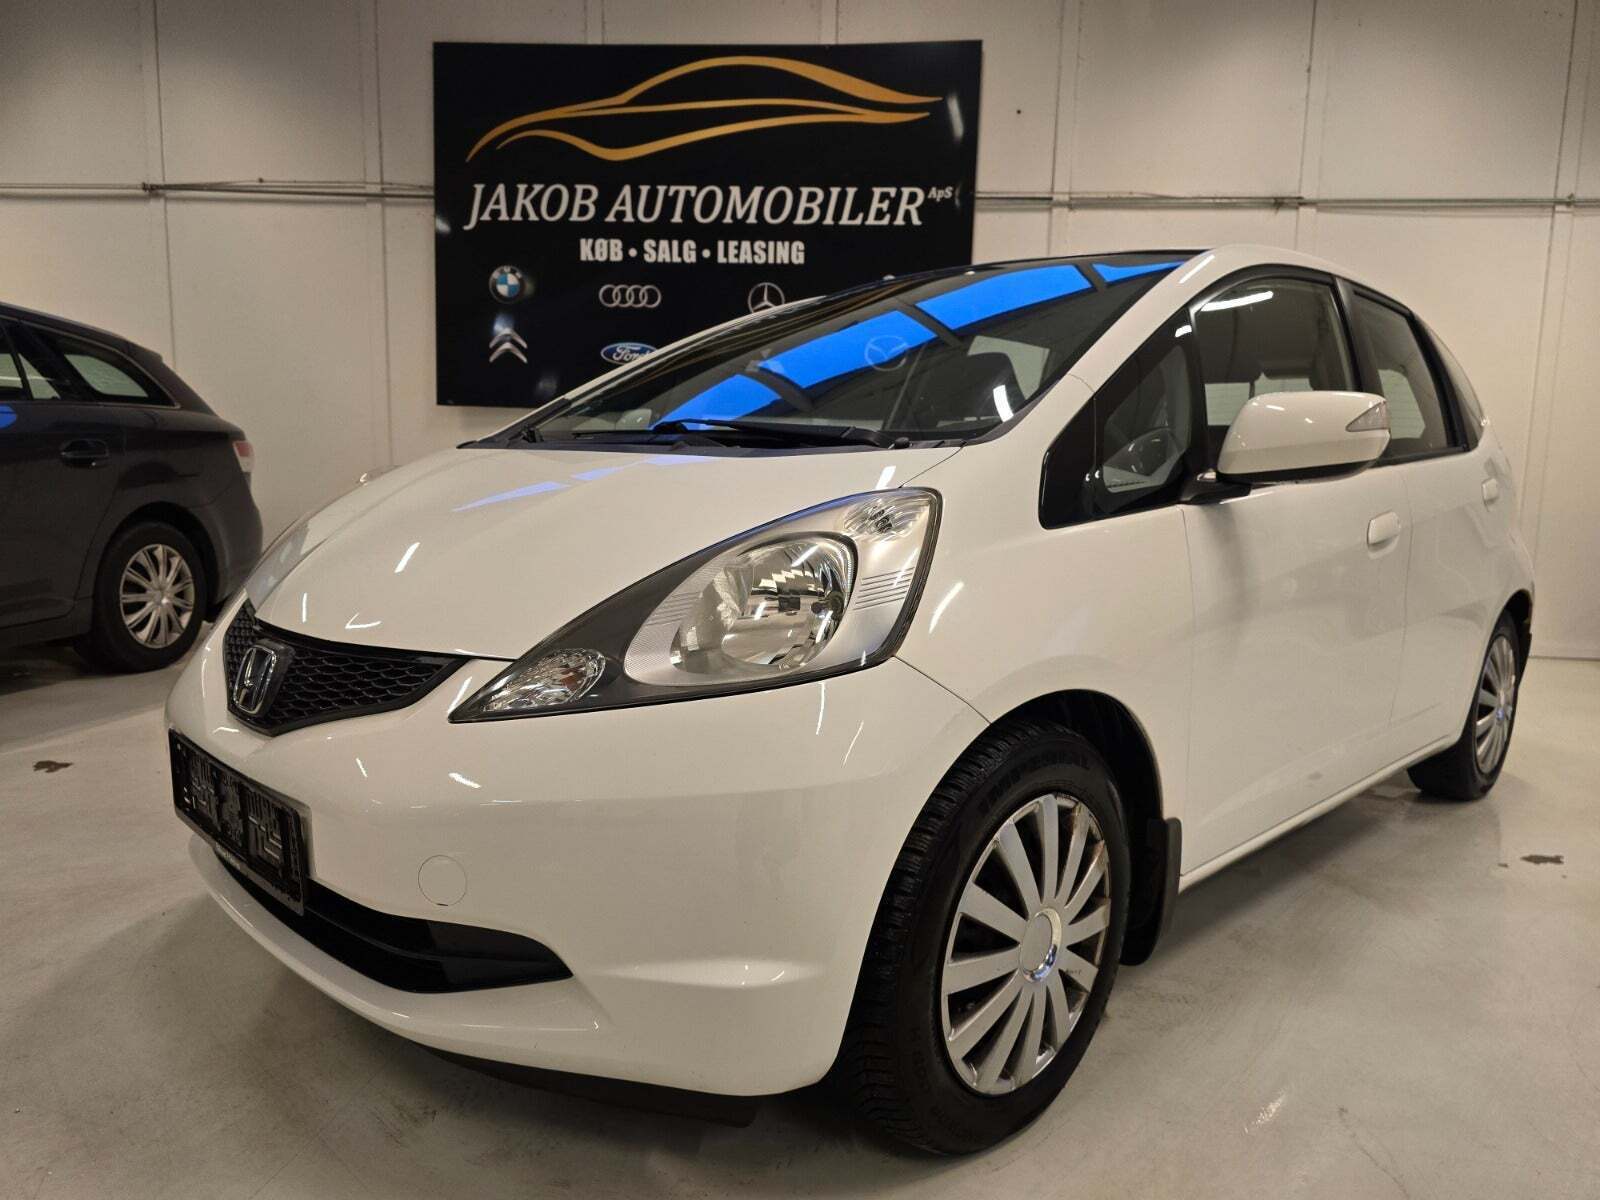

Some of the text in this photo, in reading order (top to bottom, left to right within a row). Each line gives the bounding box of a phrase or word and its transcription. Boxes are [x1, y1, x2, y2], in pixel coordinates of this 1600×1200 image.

[462, 183, 953, 231] JAKOB AUTOMOBILER ApS
[579, 237, 806, 265] KØB SALG LEASING
